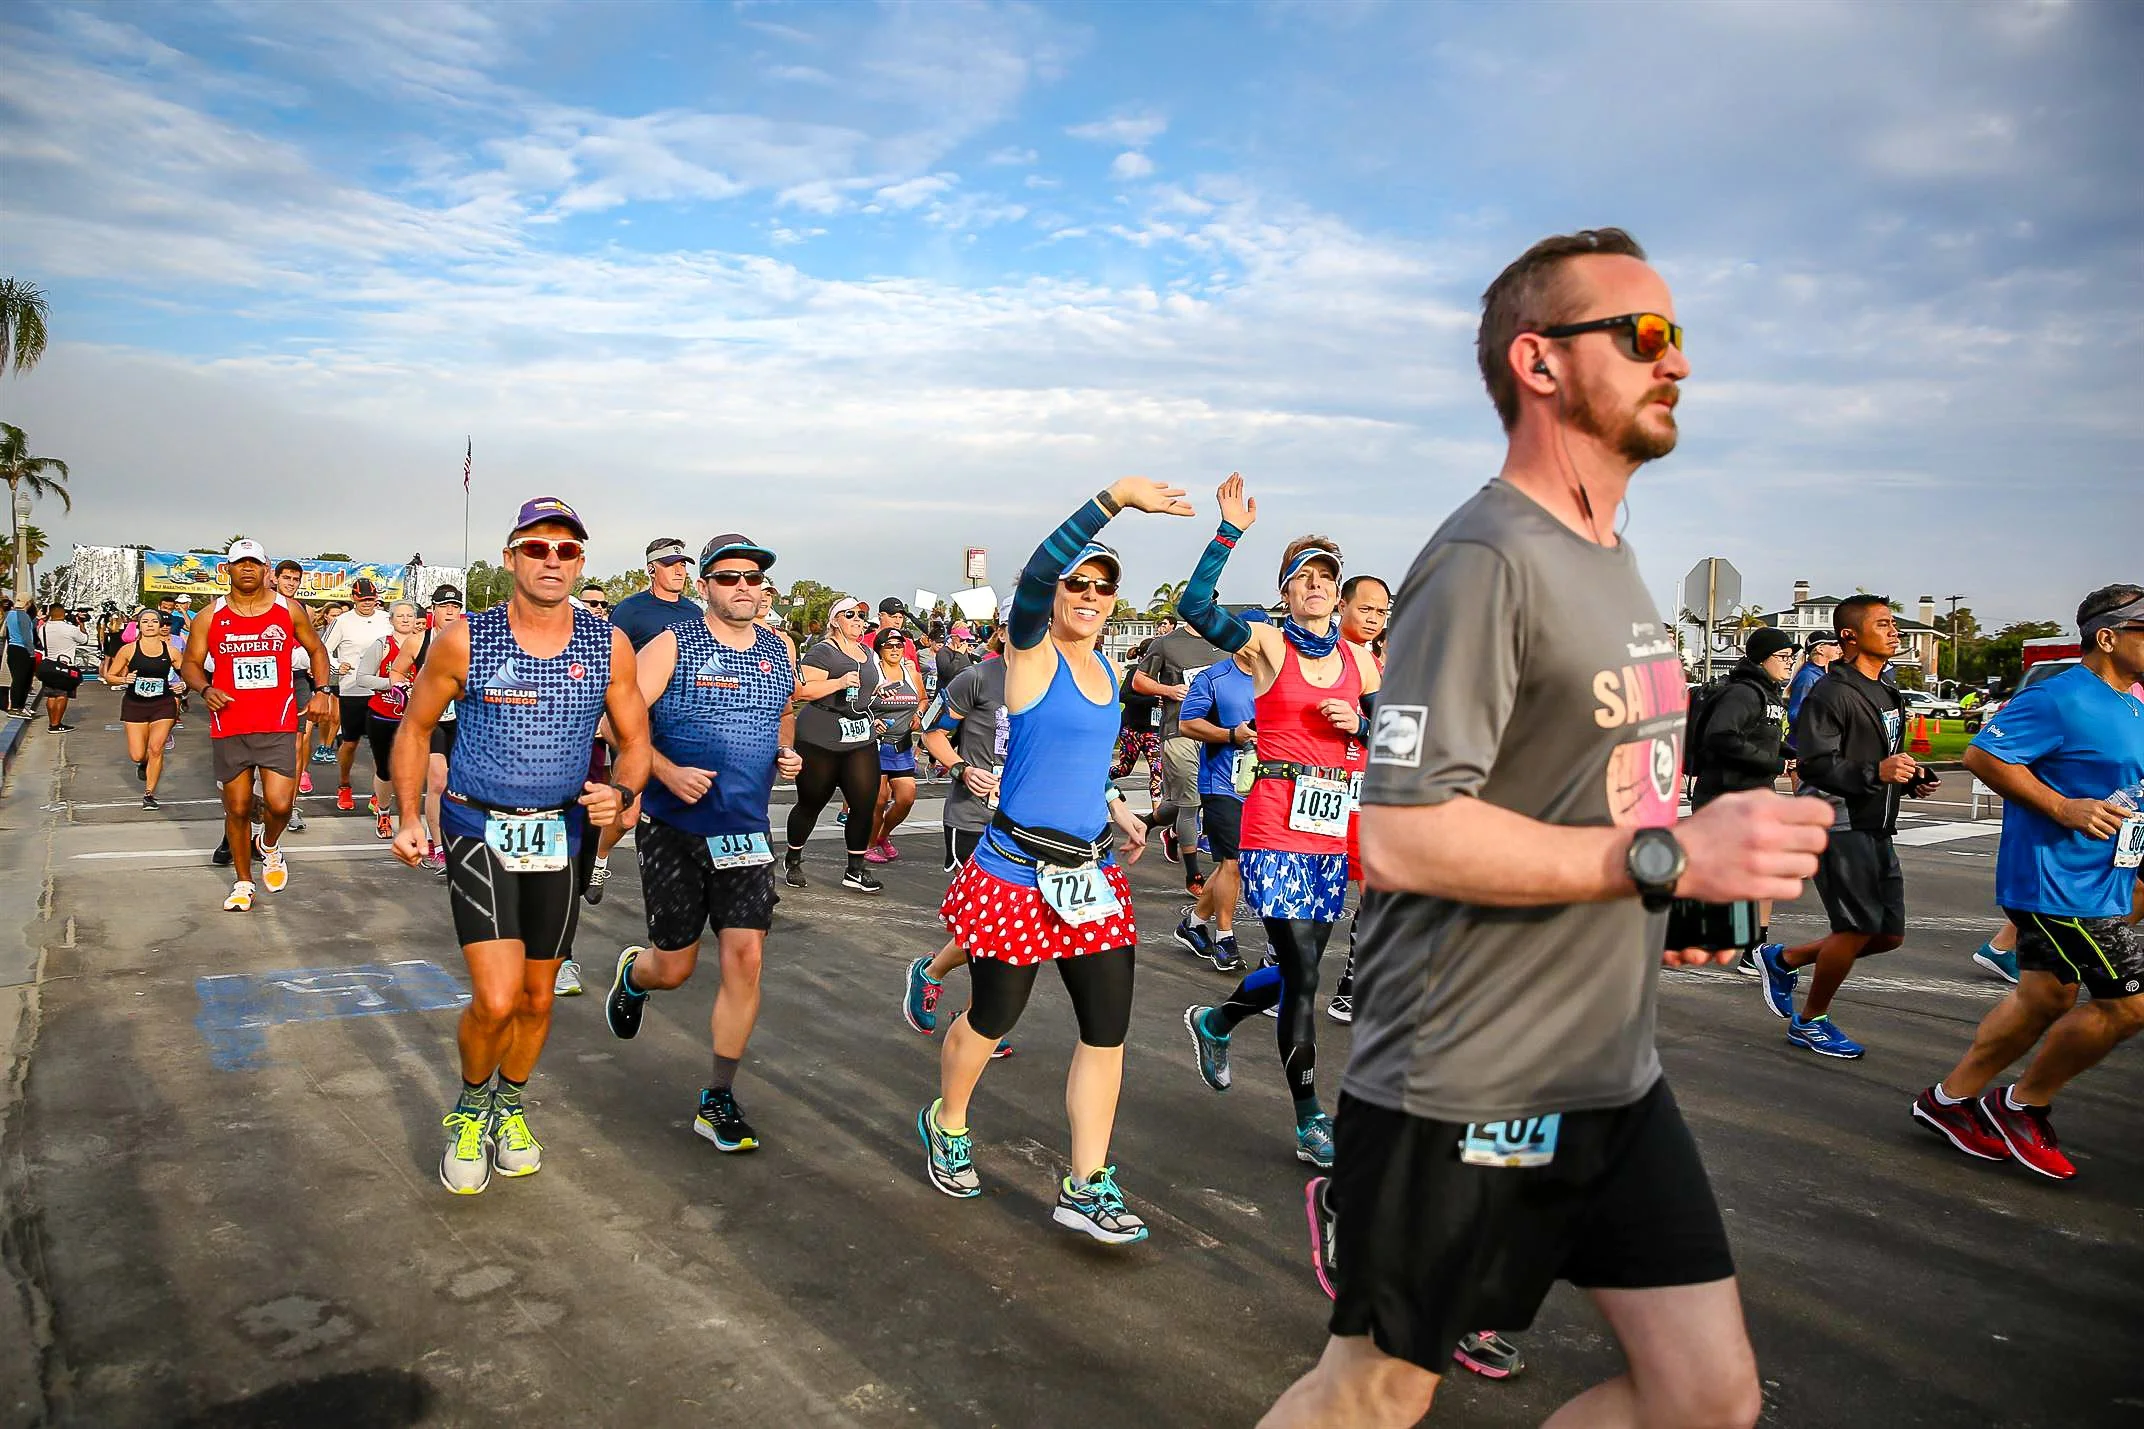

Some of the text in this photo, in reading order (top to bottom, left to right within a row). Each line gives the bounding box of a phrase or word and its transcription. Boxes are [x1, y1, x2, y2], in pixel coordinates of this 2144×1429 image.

[219, 641, 270, 654] SEMPER
[237, 664, 270, 680] 1351
[715, 675, 739, 683] CLUB
[140, 682, 156, 692] 425
[484, 688, 537, 697] TRI CLUB
[843, 720, 866, 737] 1468
[1297, 789, 1342, 820] 1033
[500, 823, 545, 853] 314
[720, 834, 753, 853] 313
[1052, 873, 1096, 907] 722
